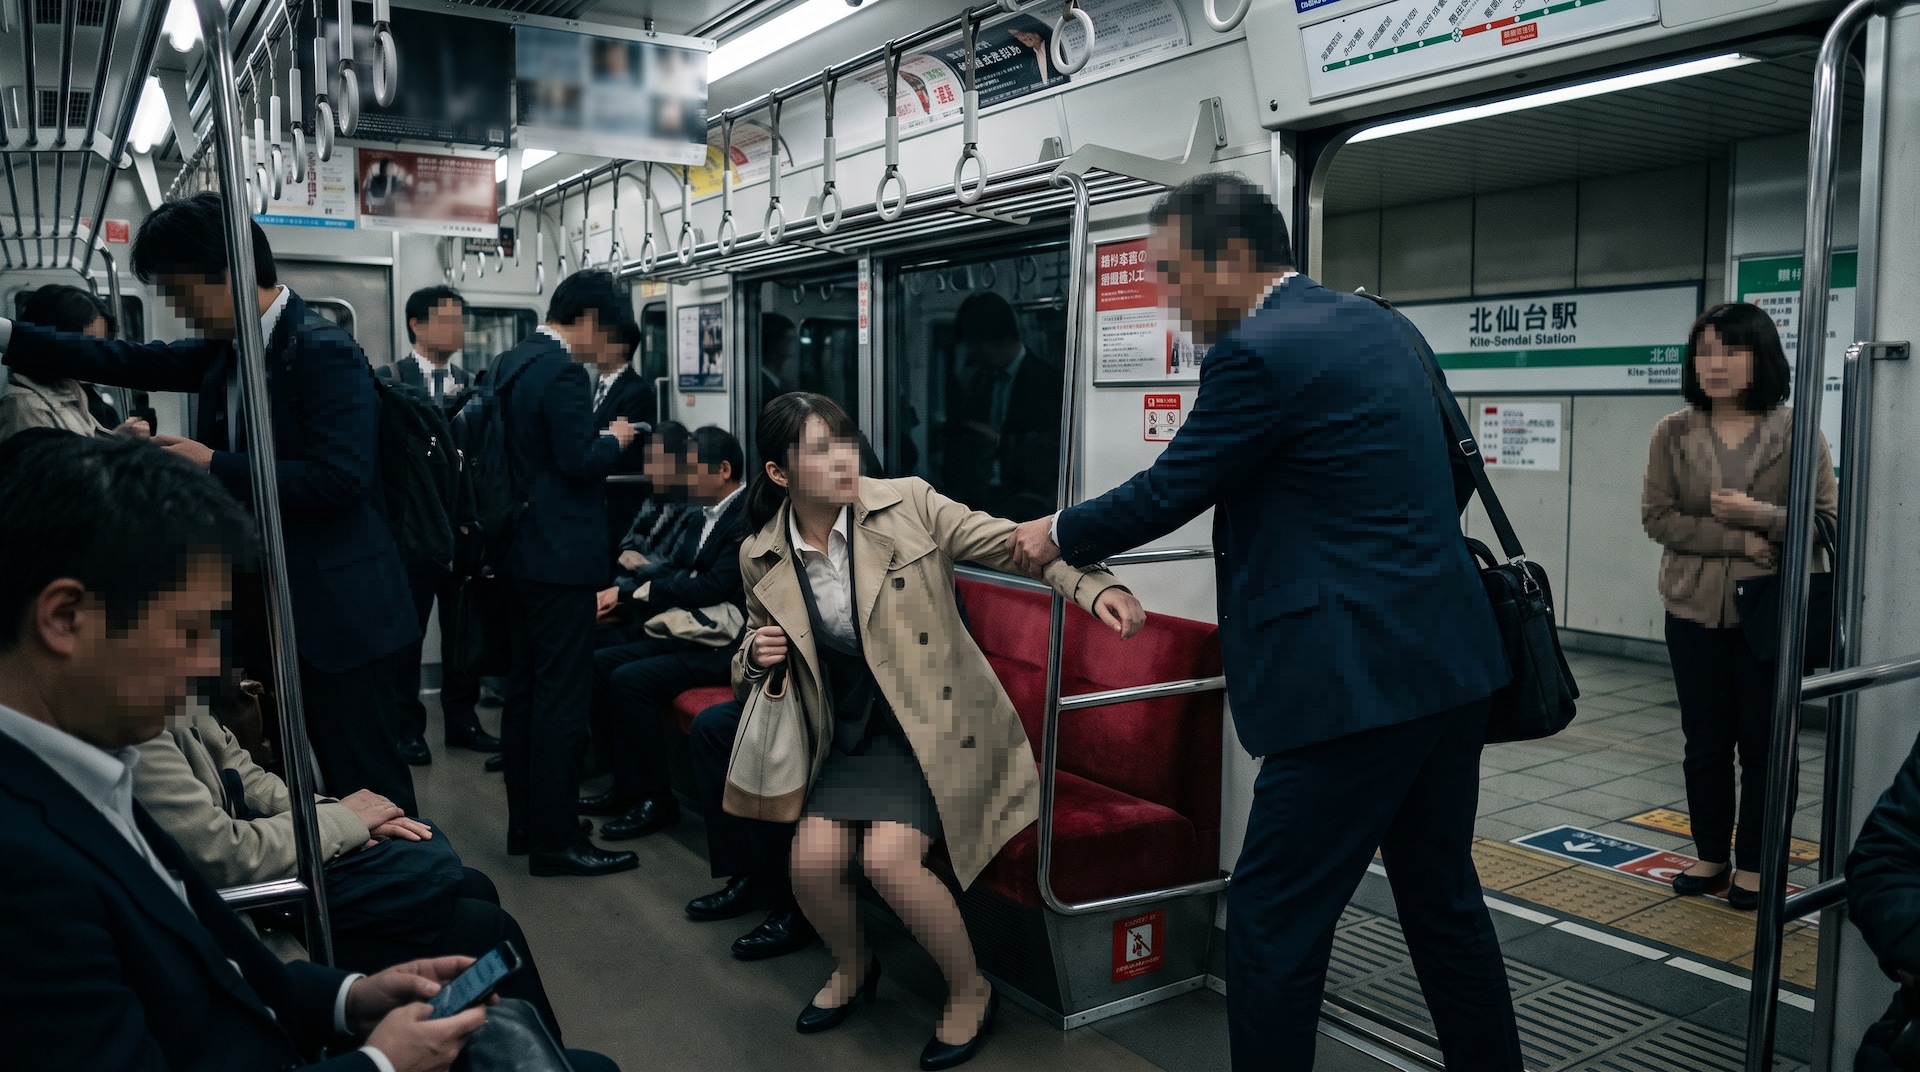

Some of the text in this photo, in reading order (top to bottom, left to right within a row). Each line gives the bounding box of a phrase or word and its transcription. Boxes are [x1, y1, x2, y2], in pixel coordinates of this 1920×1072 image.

[1470, 301, 1577, 333] 北仙台駅
[1535, 332, 1576, 345] Station
